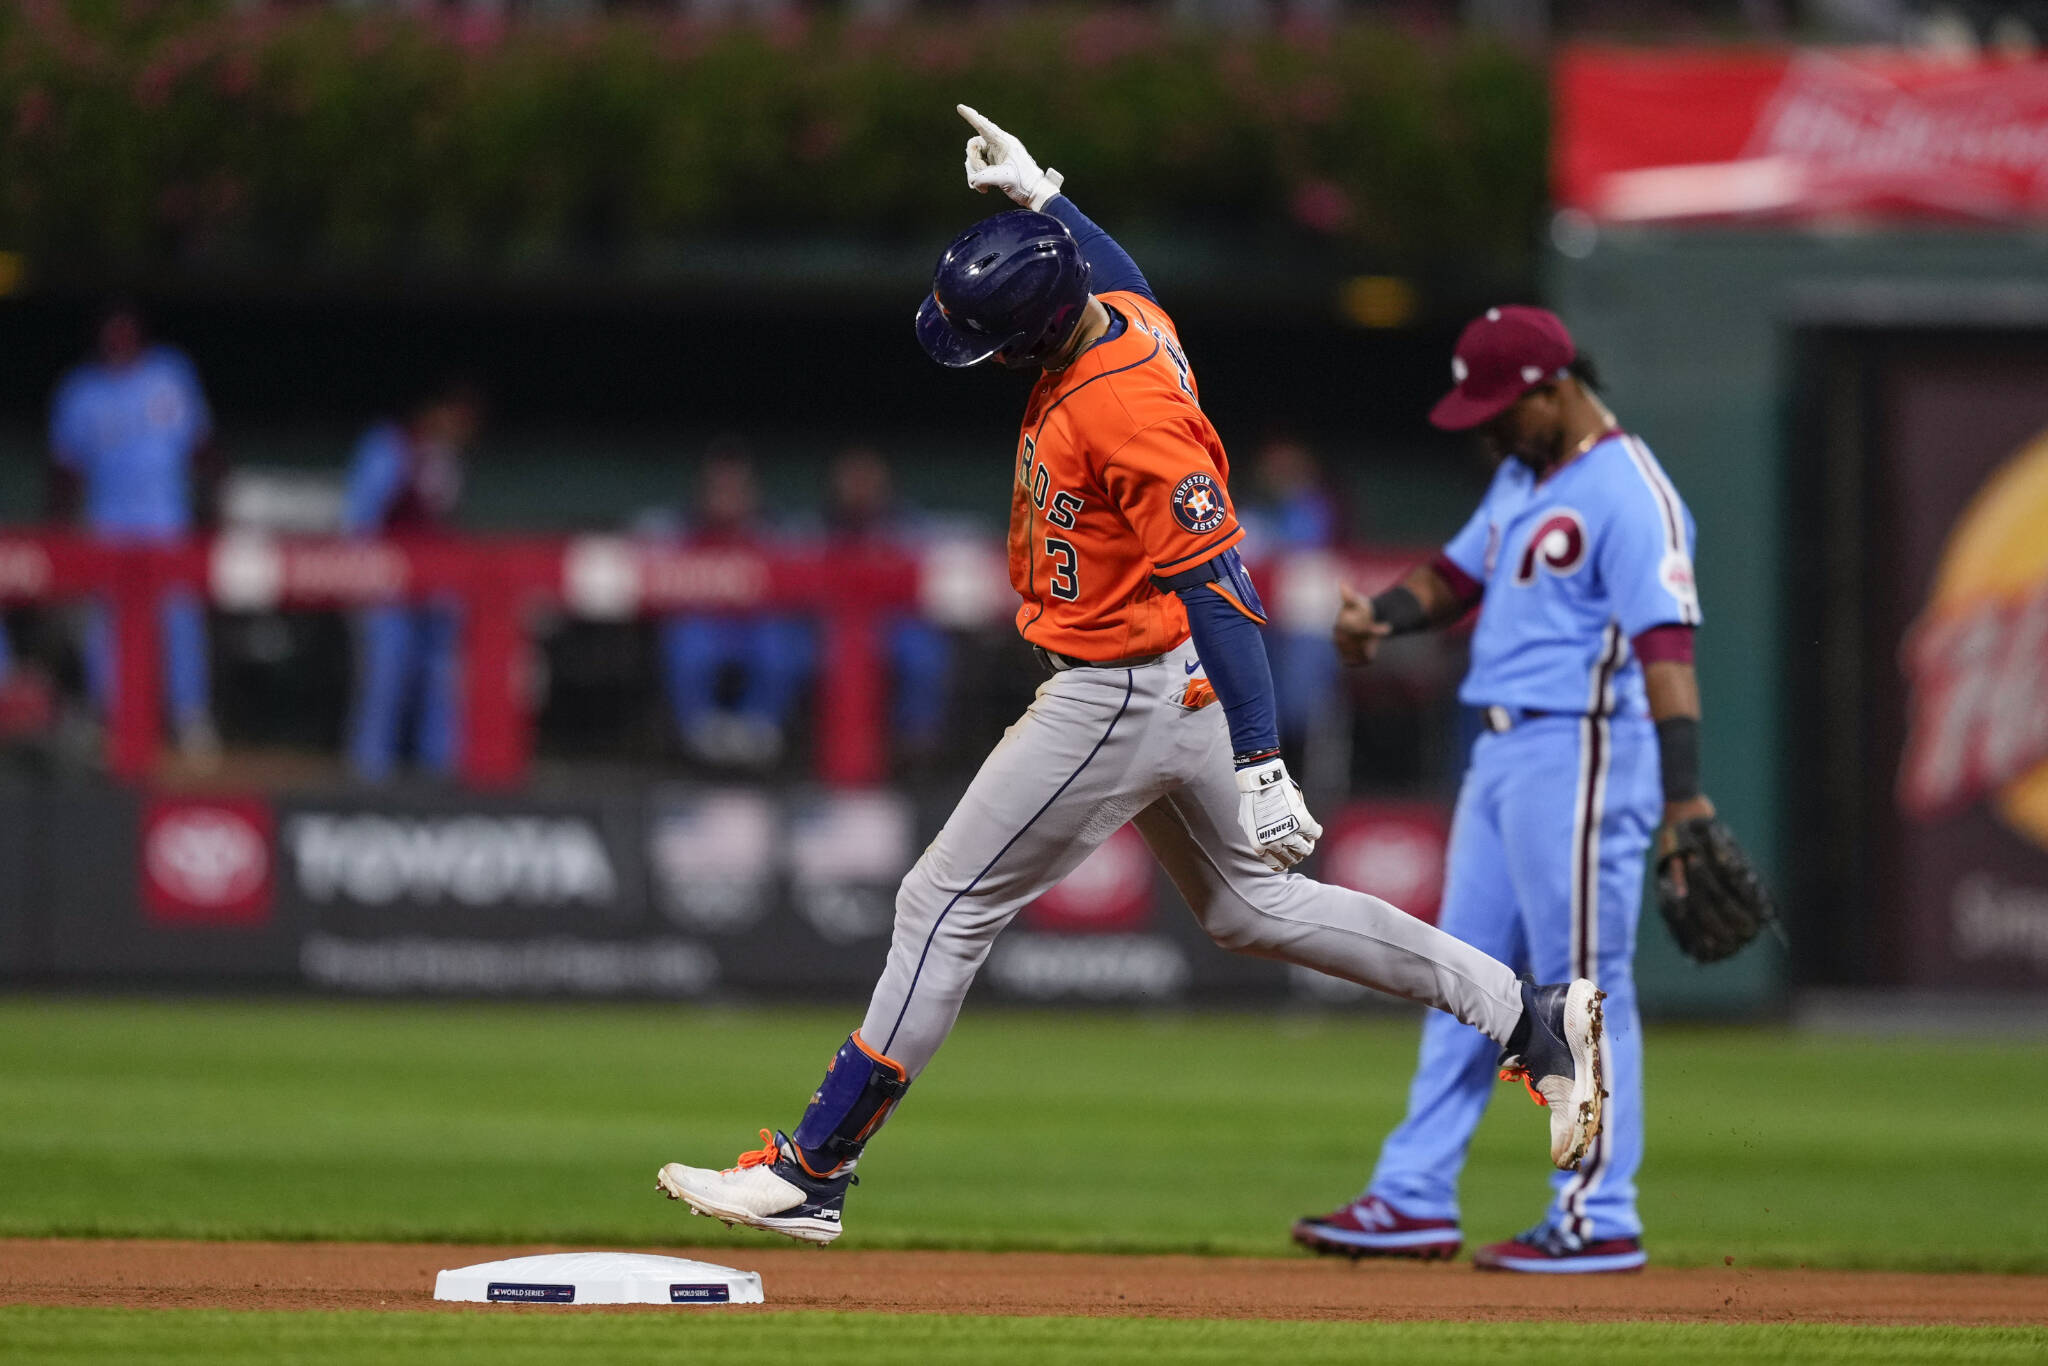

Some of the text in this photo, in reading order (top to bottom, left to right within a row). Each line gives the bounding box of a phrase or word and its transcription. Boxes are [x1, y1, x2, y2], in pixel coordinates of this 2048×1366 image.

[1173, 475, 1211, 504] HOUSTON
[1191, 506, 1225, 531] ASTROS
[1045, 537, 1080, 602] 3
[1259, 817, 1295, 840] franklin
[500, 1288, 545, 1297] WORLD SERIES
[679, 1289, 709, 1297] WORLD SERIES
